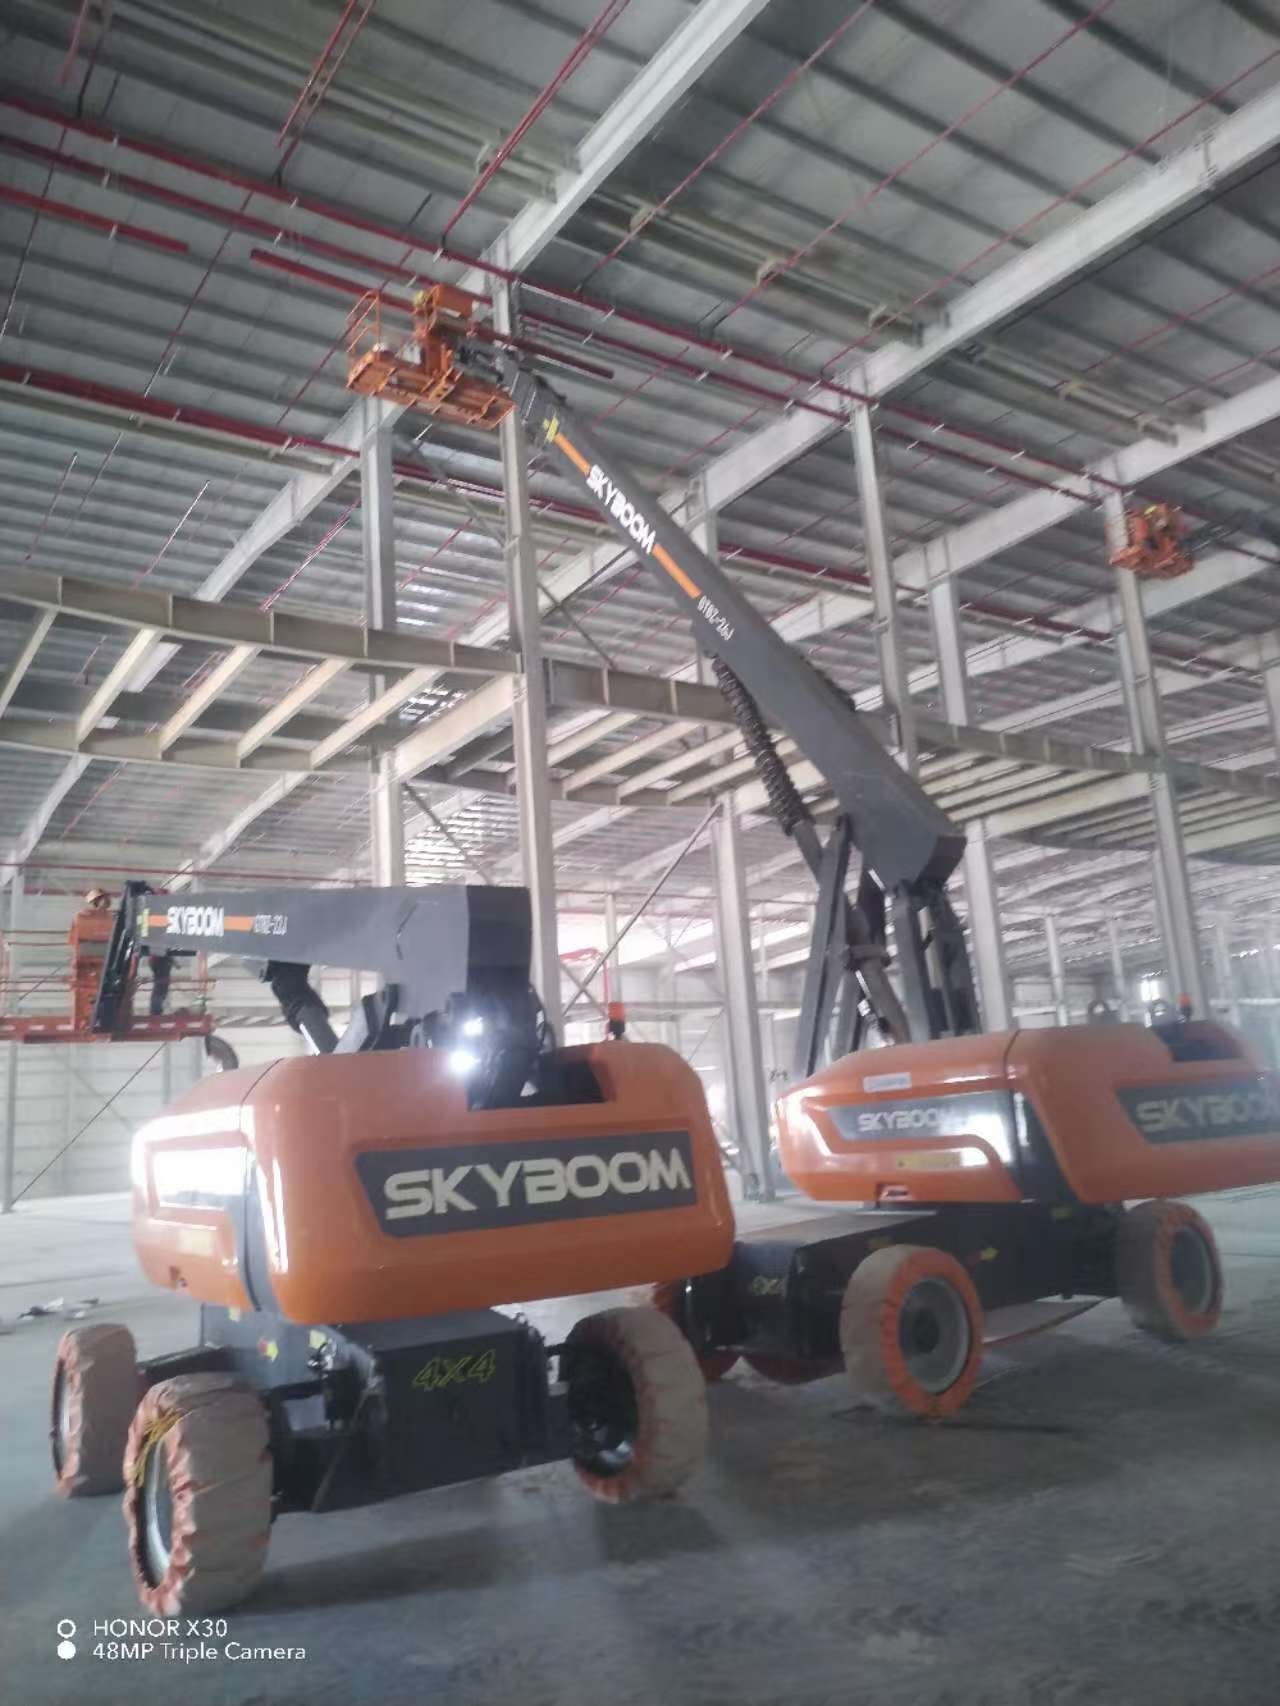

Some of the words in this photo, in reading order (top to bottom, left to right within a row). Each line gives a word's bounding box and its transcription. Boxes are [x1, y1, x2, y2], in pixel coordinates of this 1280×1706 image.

[586, 464, 656, 554] SKYBOOM
[166, 906, 224, 937] SKYBOOM
[858, 1107, 954, 1132] SKYBOO
[384, 1148, 691, 1219] SKYBOOM
[412, 1348, 496, 1392] 4X4
